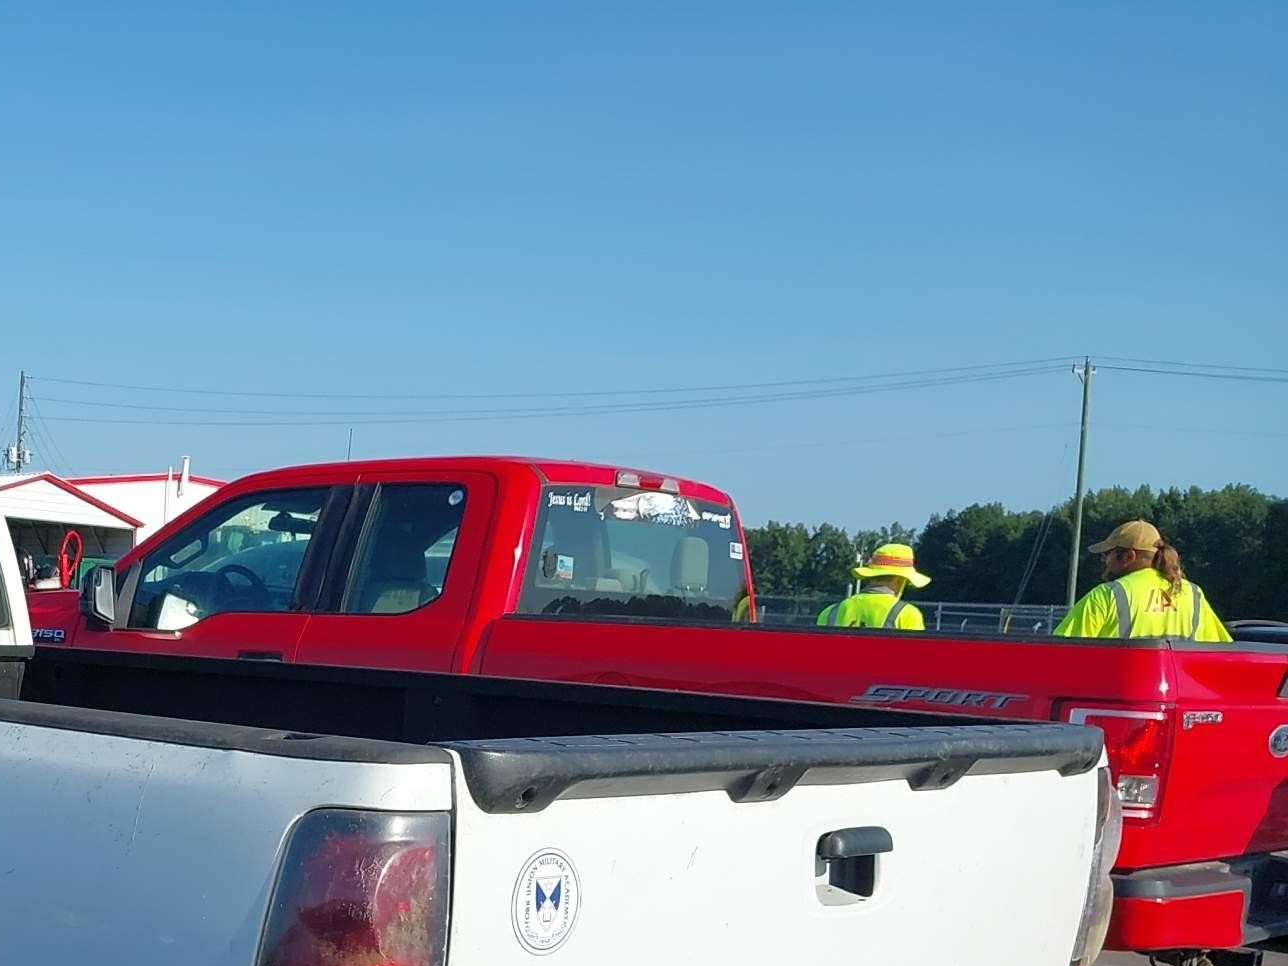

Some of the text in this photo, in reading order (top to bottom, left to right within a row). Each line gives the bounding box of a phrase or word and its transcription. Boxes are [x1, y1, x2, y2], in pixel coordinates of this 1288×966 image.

[548, 491, 565, 507] Jesus
[566, 492, 572, 506] is
[849, 684, 1030, 711] SPORT
[525, 864, 538, 896] UNION
[538, 857, 566, 873] MILITARY
